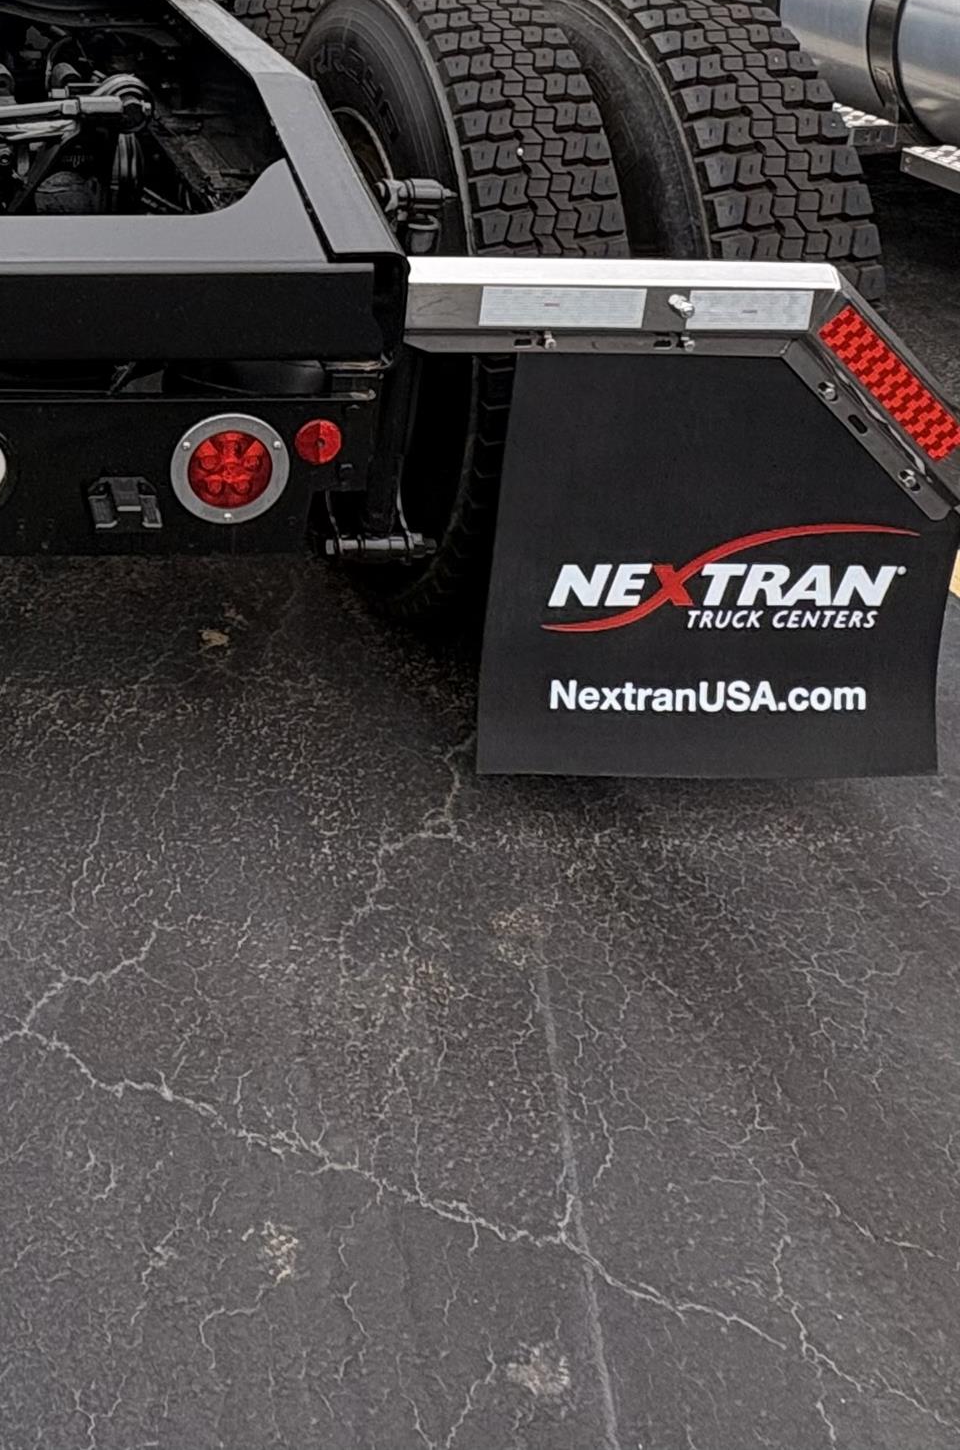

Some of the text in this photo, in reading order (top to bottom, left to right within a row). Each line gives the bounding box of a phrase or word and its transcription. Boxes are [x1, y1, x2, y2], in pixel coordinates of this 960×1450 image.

[547, 562, 898, 608] NEXTRAN
[687, 609, 879, 629] TRUCK CENTERS
[549, 679, 867, 713] NextranUSA.com
